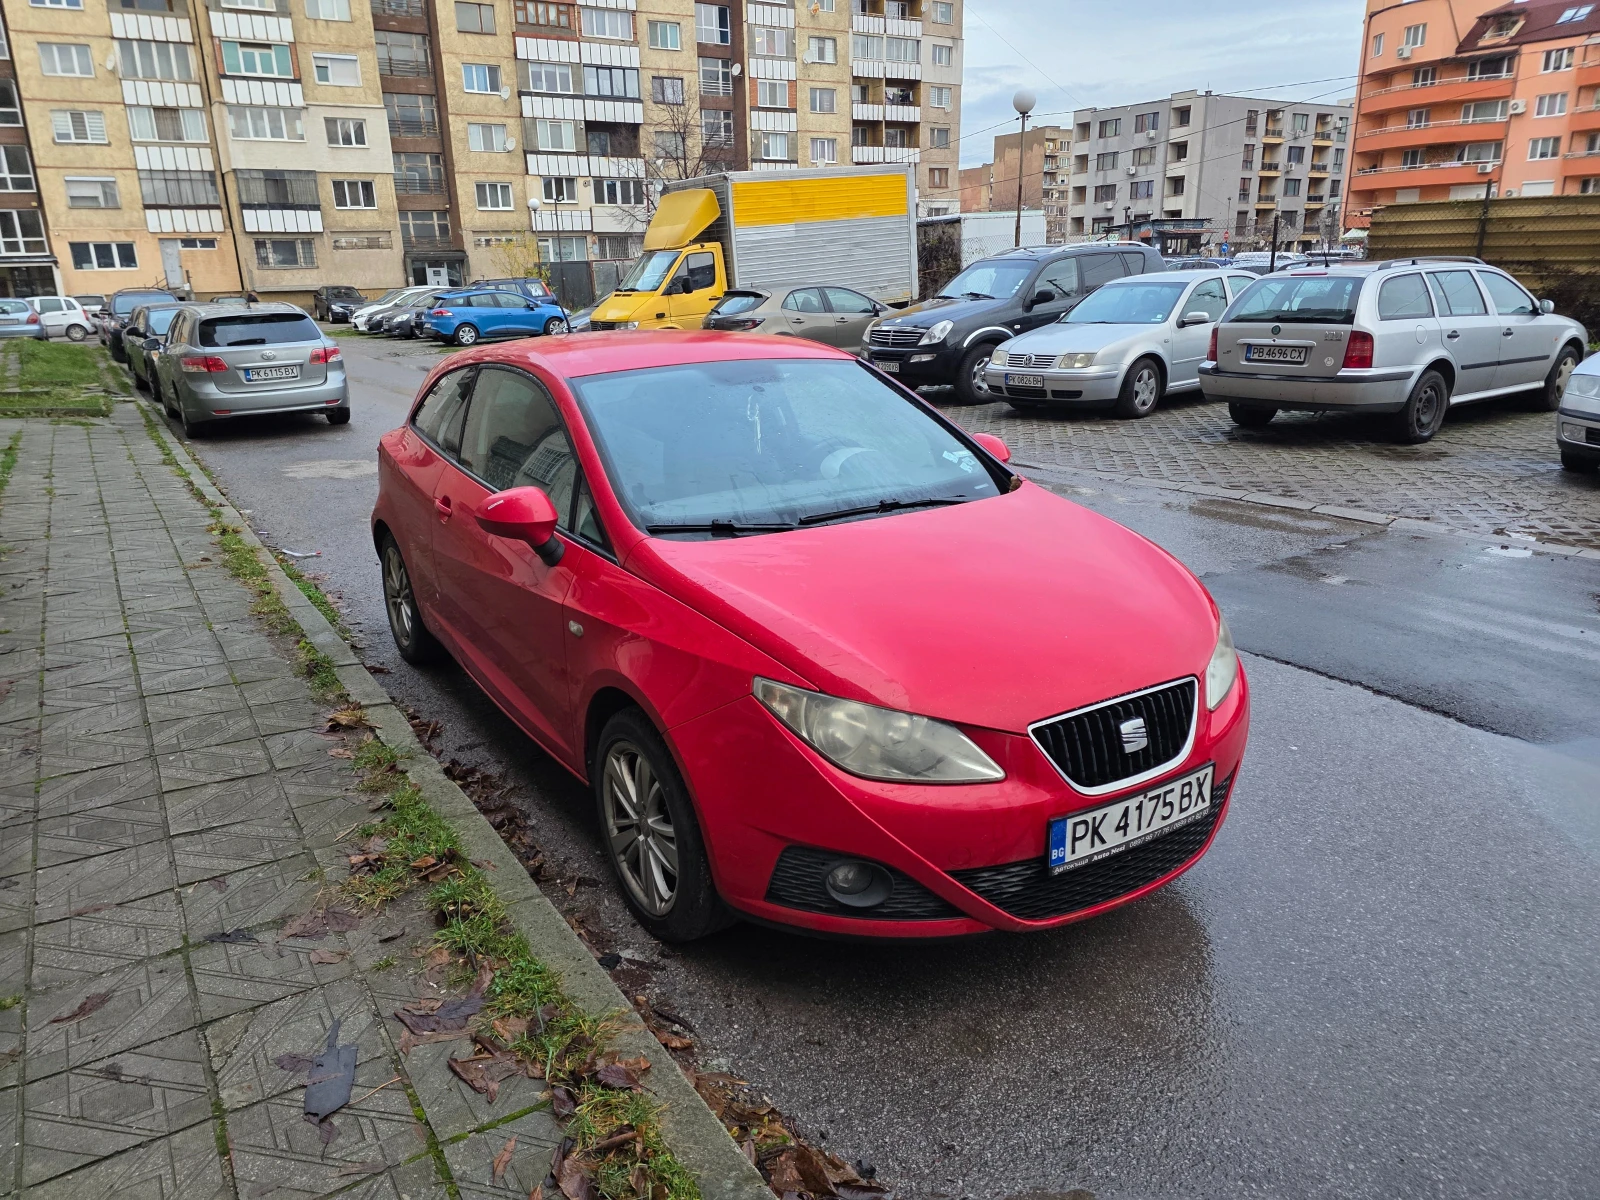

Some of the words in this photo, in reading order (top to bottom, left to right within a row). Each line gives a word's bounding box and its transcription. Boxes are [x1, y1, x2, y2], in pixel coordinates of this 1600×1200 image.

[1252, 347, 1264, 357] PB
[1266, 348, 1288, 358] 4696
[1290, 349, 1304, 360] CX
[251, 369, 263, 378] PK
[264, 368, 284, 377] 6115
[285, 367, 296, 375] BX
[1008, 376, 1017, 384] PK
[1051, 846, 1065, 860] BG
[1071, 812, 1109, 855] PK
[1115, 787, 1175, 837] 4175
[1179, 772, 1209, 814] BX
[1092, 852, 1110, 862] Auto
